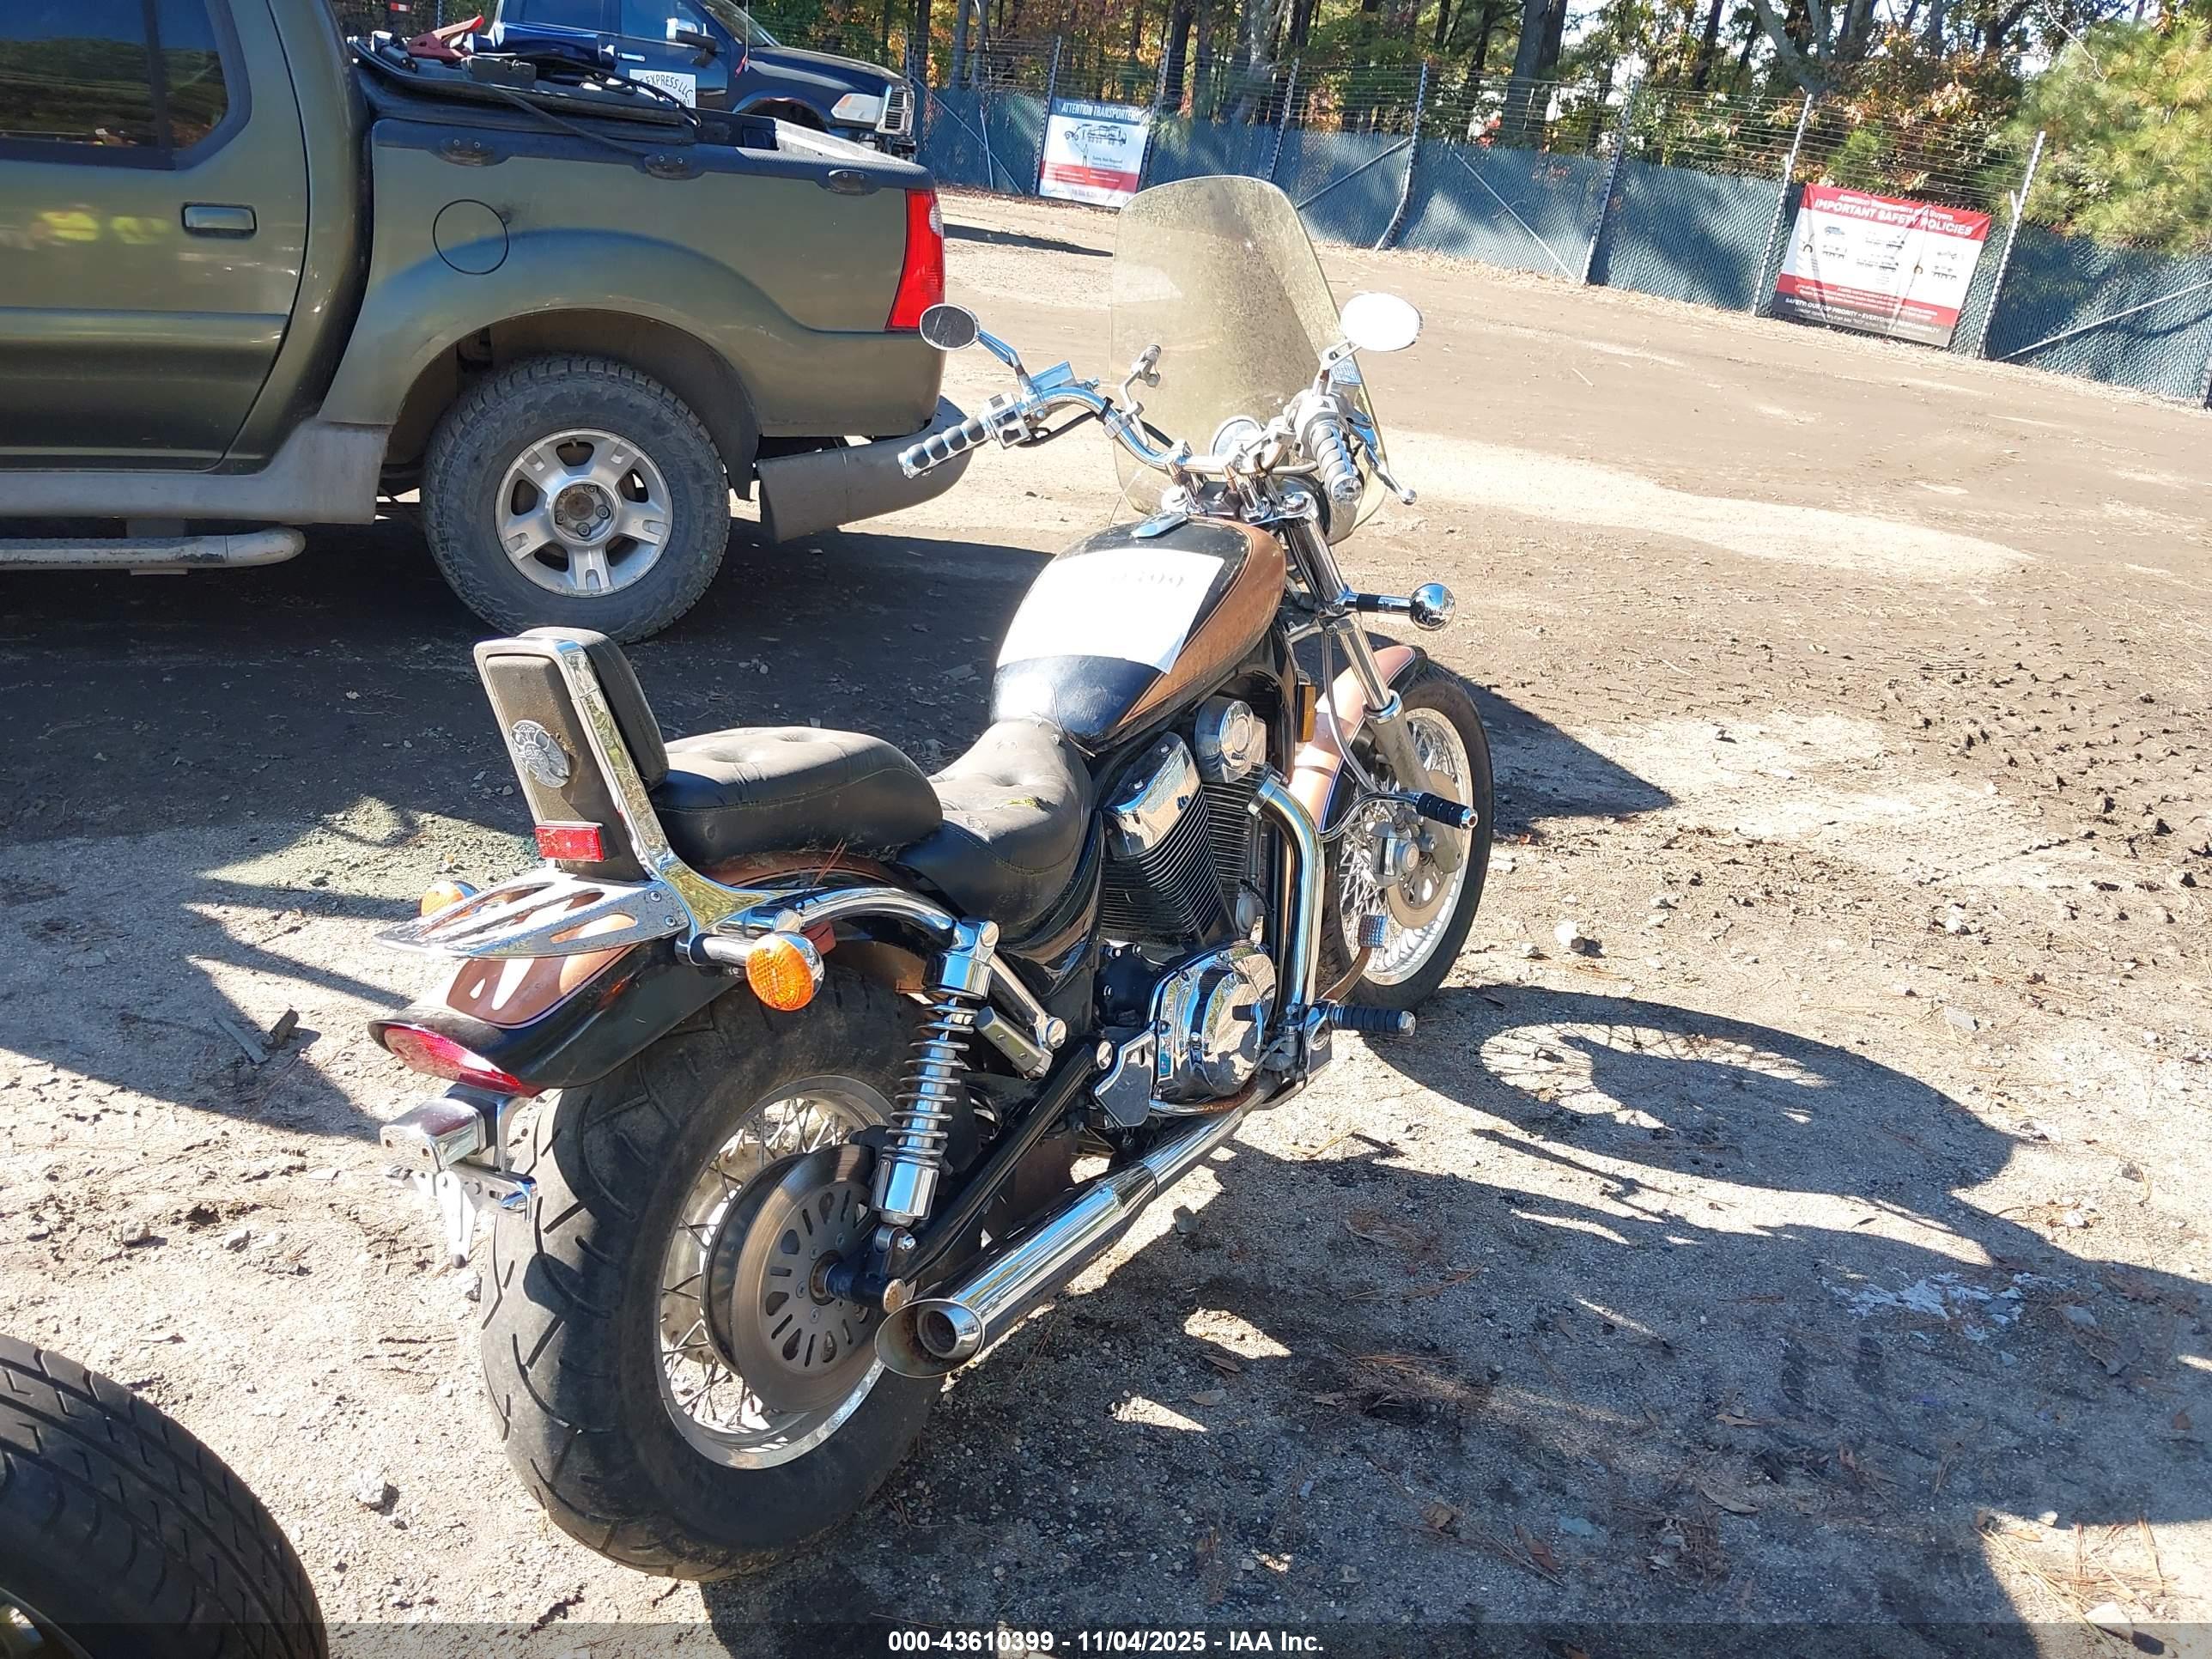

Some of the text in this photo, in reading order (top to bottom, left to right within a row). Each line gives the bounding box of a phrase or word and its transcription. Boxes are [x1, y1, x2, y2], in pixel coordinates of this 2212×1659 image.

[646, 74, 693, 98] EXPRESS LLC
[1061, 102, 1092, 116] ATTENTION
[1814, 198, 1973, 237] IMPORTANT SAFETY POLICIES
[1929, 209, 1954, 222] Buyers
[1808, 301, 1820, 310] OUR
[1832, 307, 1858, 317] PRIORITY
